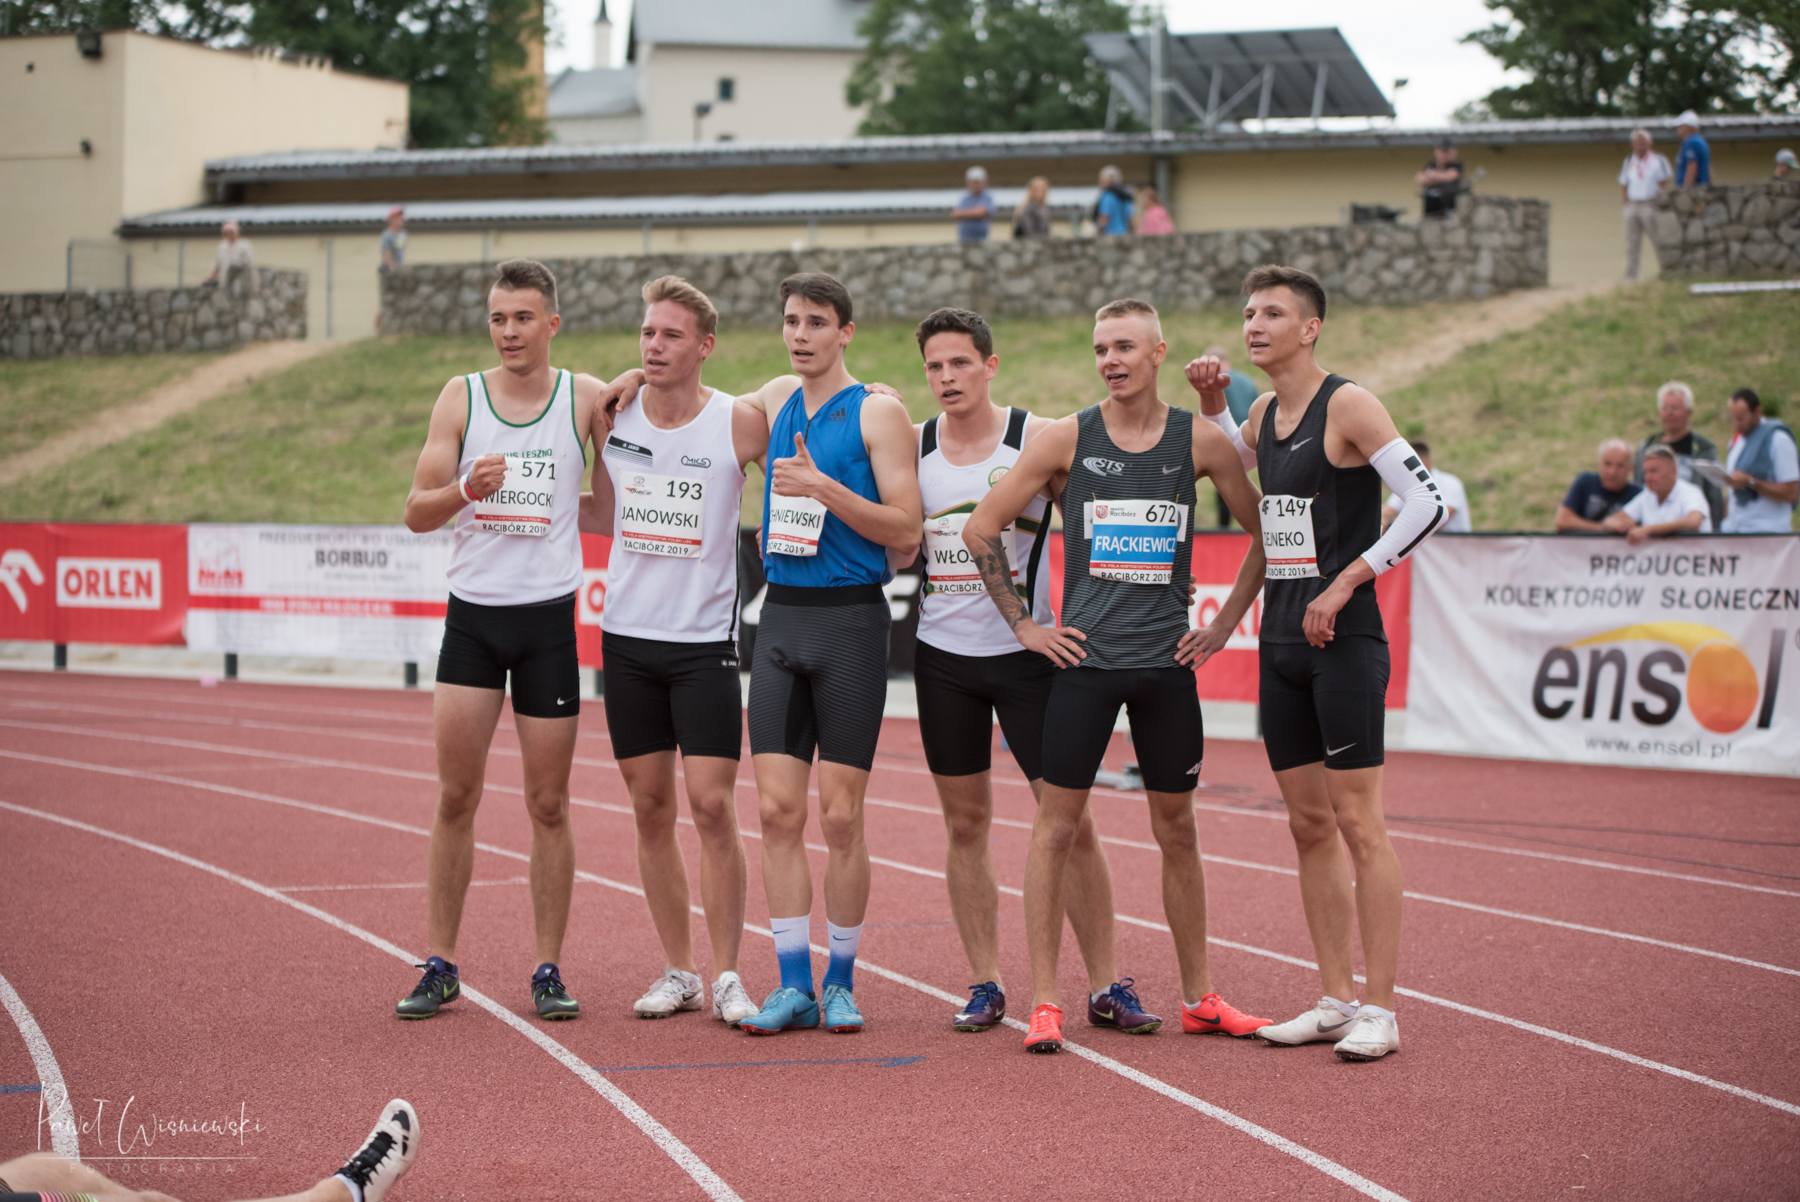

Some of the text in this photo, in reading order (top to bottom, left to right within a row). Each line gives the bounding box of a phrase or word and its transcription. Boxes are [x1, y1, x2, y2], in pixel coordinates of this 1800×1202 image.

[522, 448, 553, 459] LESZNO
[521, 461, 556, 480] 571
[1096, 458, 1125, 473] STS
[479, 490, 553, 508] WIERGOCK
[666, 480, 703, 500] 193
[1145, 504, 1176, 523] 672
[1276, 498, 1307, 517] 149
[621, 506, 699, 529] JANOWSKI
[482, 522, 526, 533] RACIBÓRZ
[624, 539, 689, 555] RACIBÓRZ 2019
[784, 543, 805, 555] 2019
[1094, 535, 1177, 555] FRĄCKIEWICZ
[315, 549, 389, 567] BORBUD
[1589, 555, 1741, 578] PRODUCENT
[1101, 570, 1151, 581] RACIBÓRZ
[1287, 567, 1307, 576] 2019
[63, 568, 153, 598] ORLEN
[939, 581, 983, 593] RACIBÓRZ
[1485, 583, 1800, 610] KOLEKTORÓW SŁONECZN
[1532, 628, 1787, 735] ensol
[1584, 736, 1732, 759] www.ensol.pl
